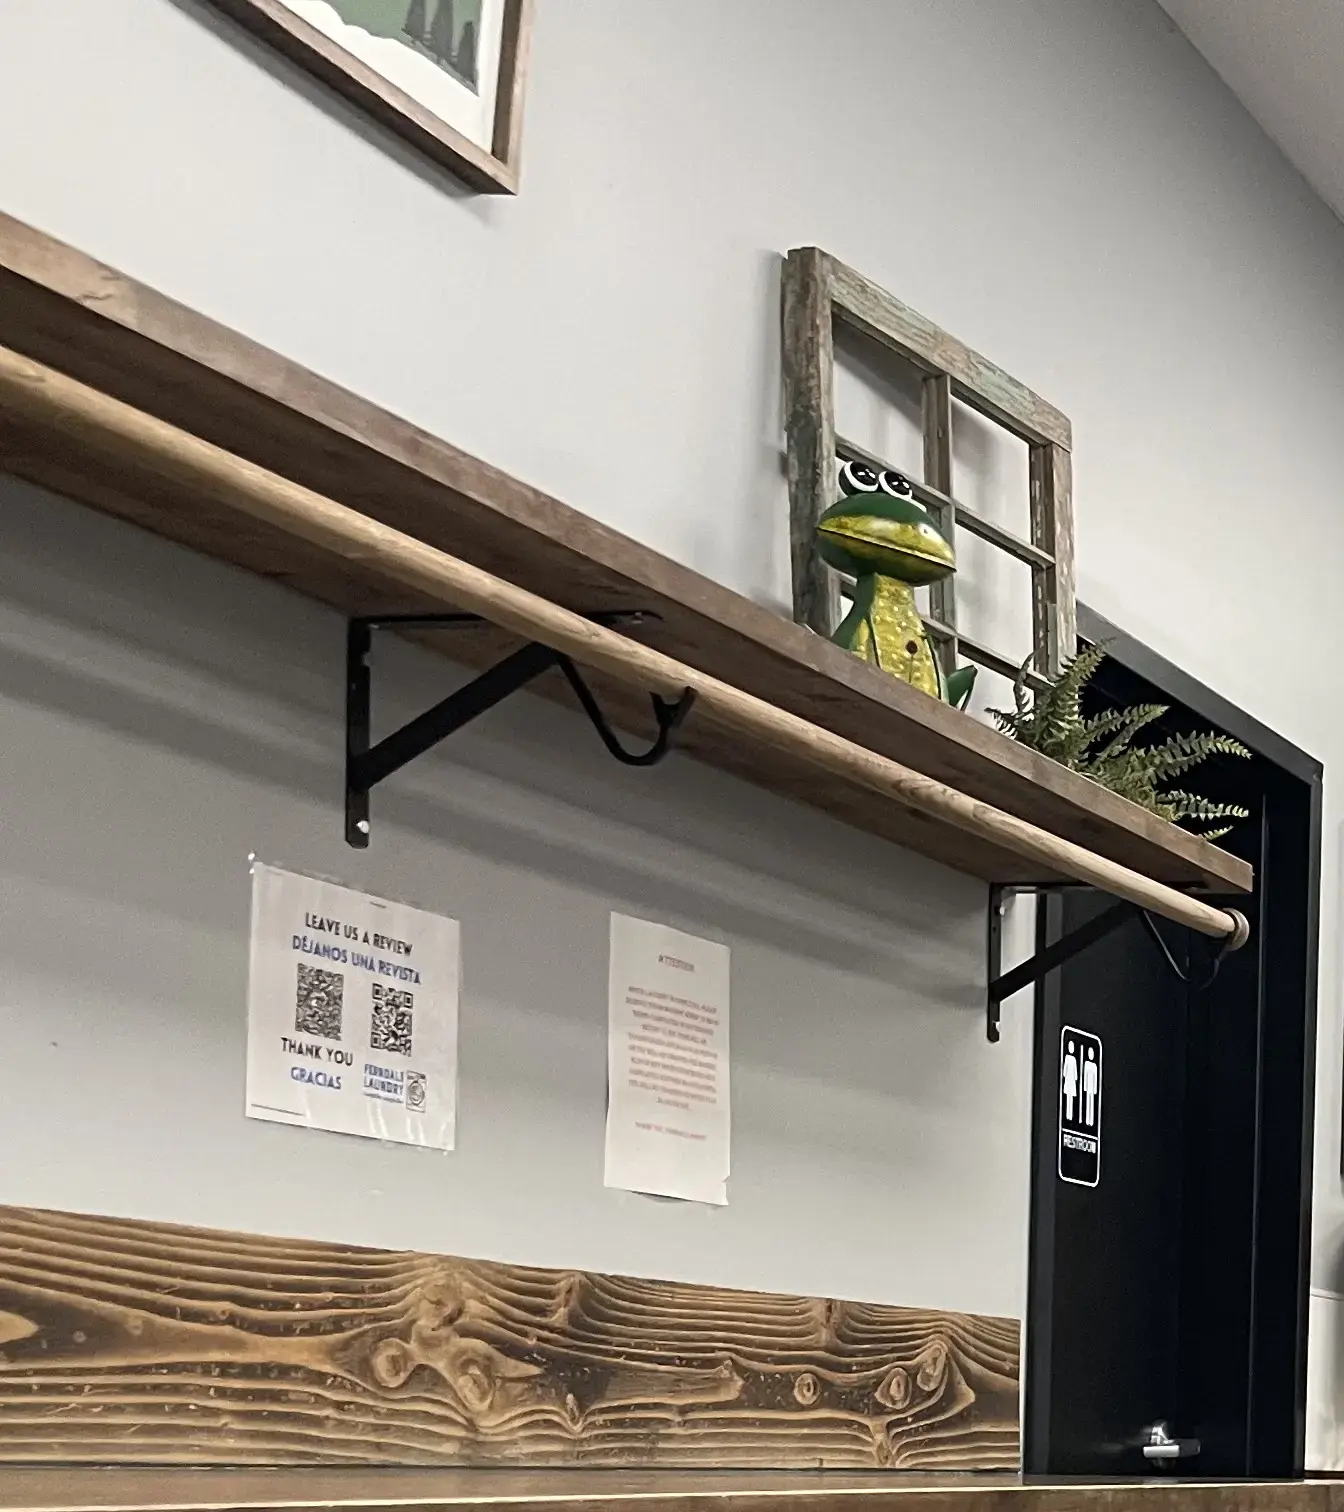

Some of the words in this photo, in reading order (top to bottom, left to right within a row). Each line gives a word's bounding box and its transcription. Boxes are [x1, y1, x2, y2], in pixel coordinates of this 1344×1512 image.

[305, 912, 341, 936] LEAVE
[343, 924, 359, 941] US
[362, 931, 370, 945] A
[373, 933, 413, 957] REVIEW
[292, 935, 348, 964] DÉJANOS
[351, 951, 376, 973] UNA
[378, 959, 422, 985] REVISTA
[280, 1037, 322, 1060] THANK
[326, 1047, 354, 1066] YOU
[290, 1066, 342, 1090] GRACIAS
